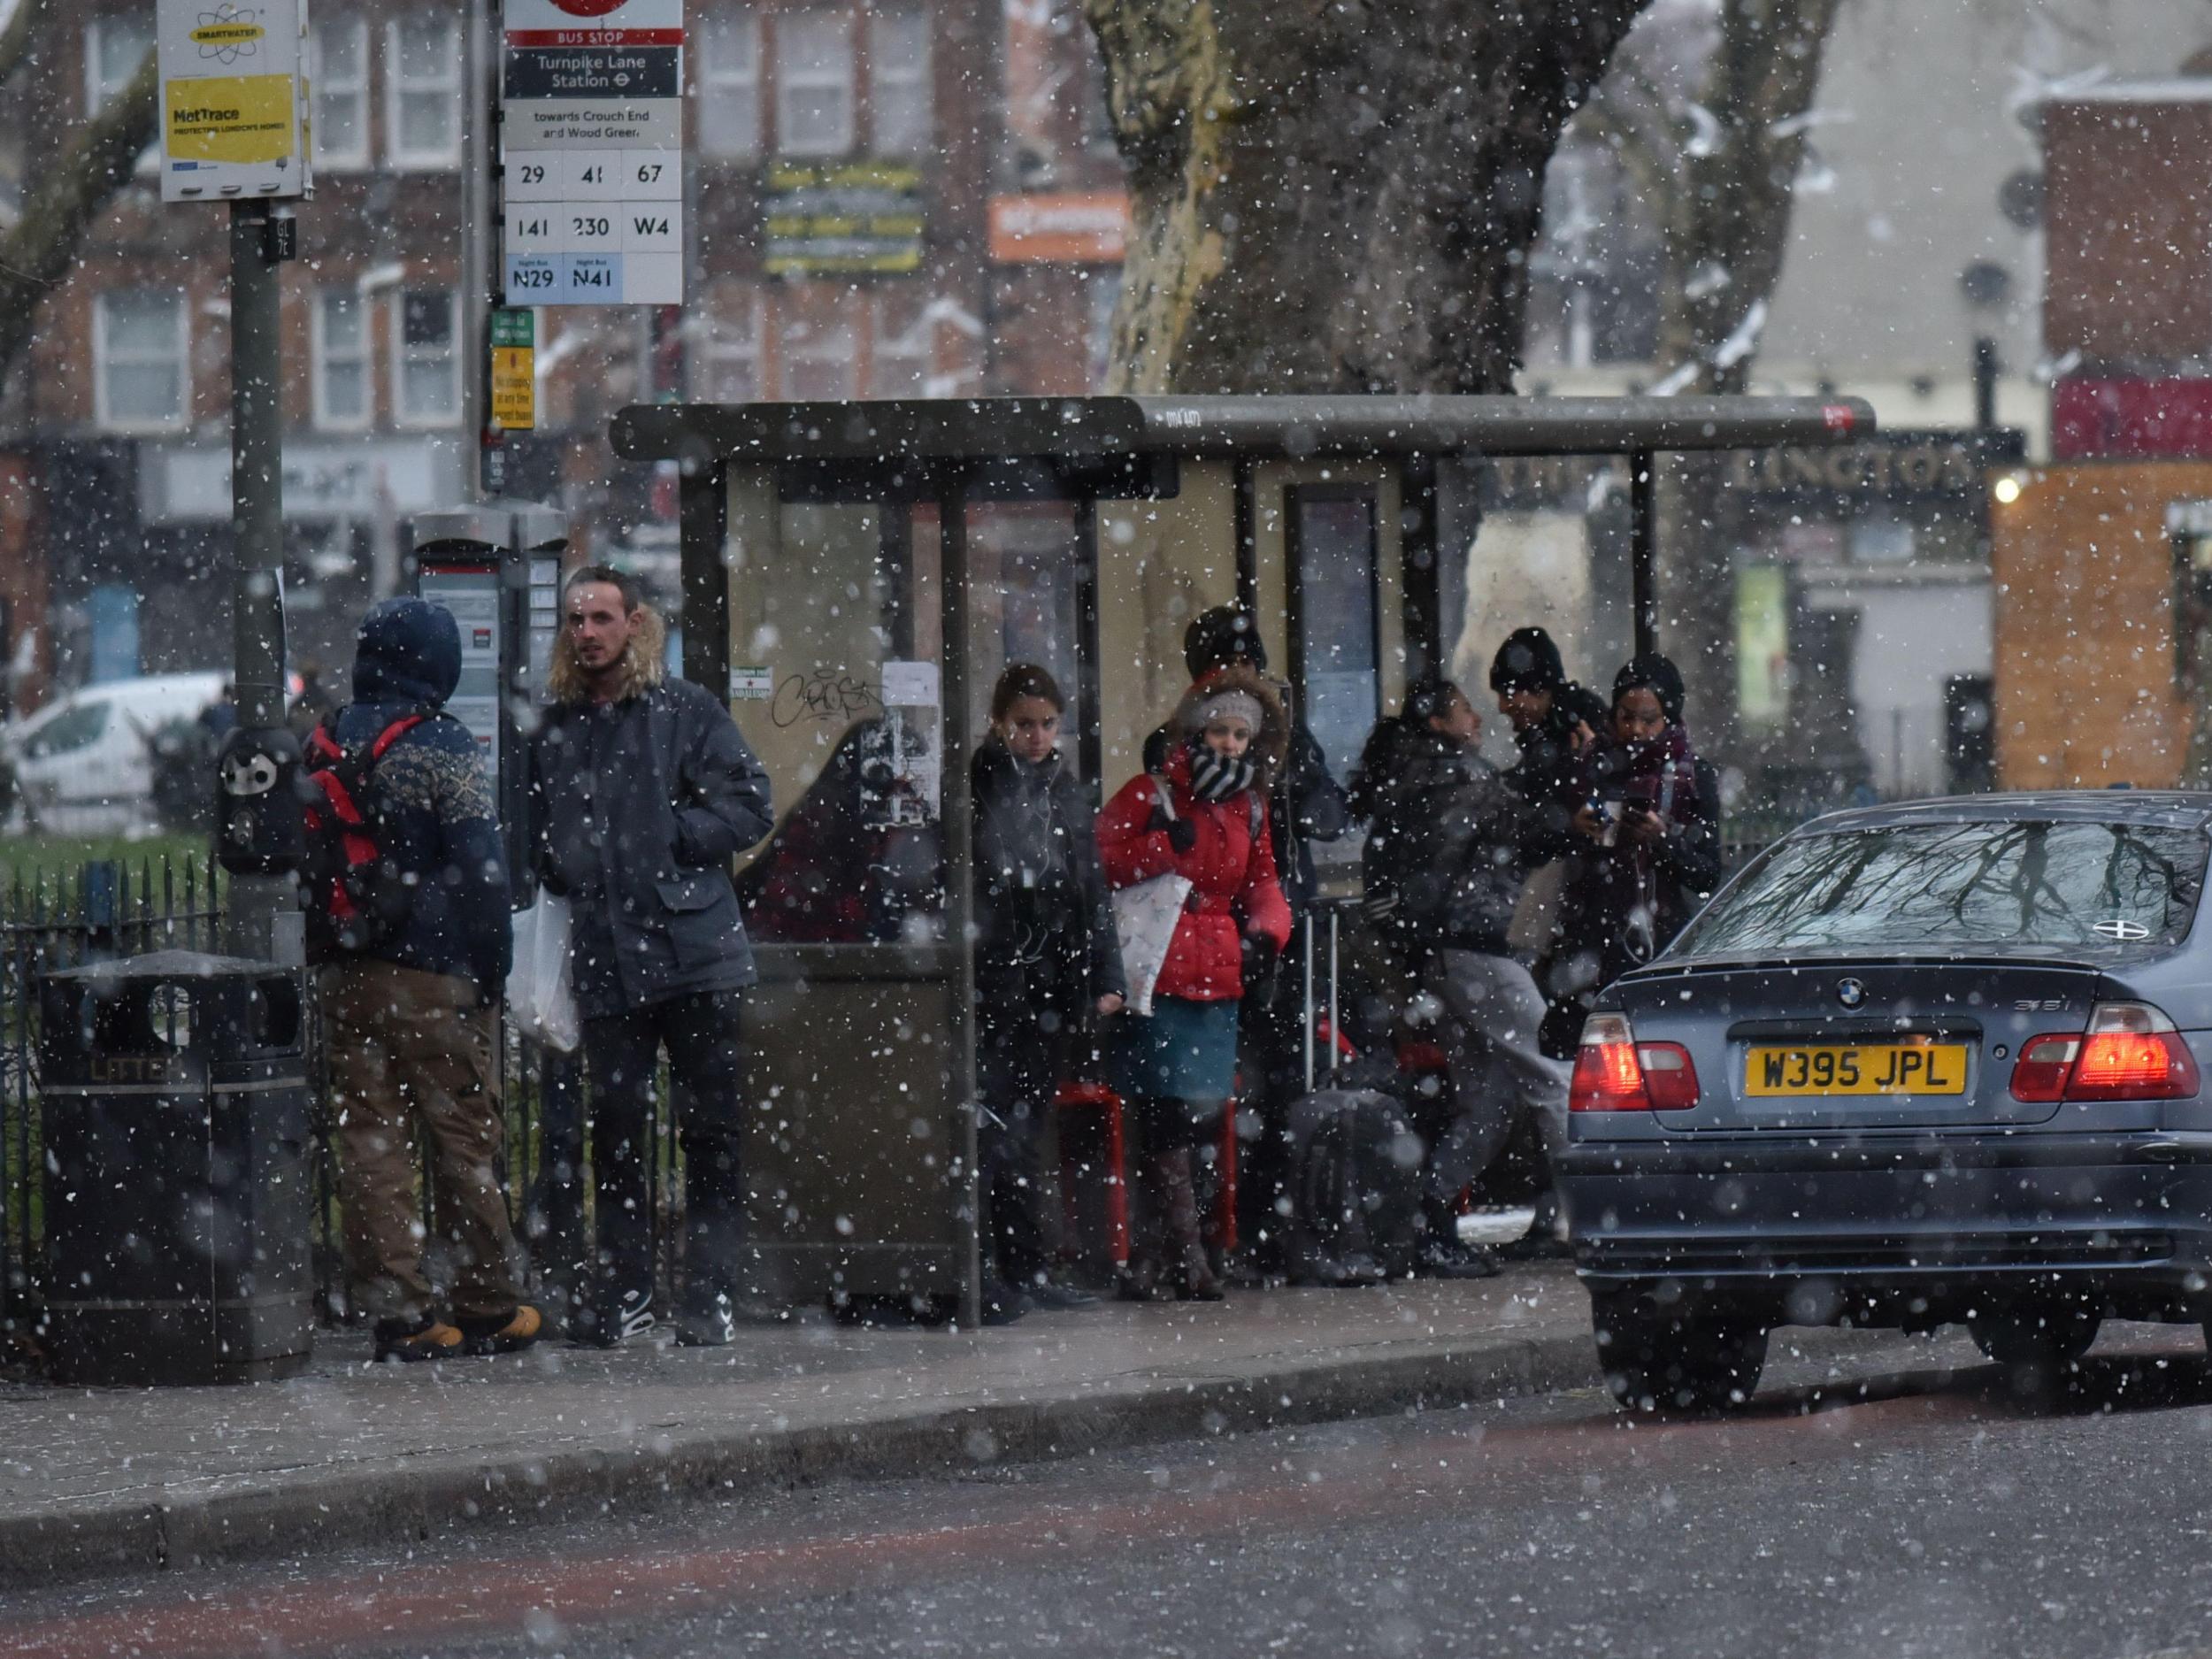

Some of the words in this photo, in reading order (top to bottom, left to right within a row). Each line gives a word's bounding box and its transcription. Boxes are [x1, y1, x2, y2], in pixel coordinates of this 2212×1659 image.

[197, 28, 257, 40] SMARTWATER
[558, 32, 583, 43] BUS
[588, 32, 624, 43] STOP
[538, 55, 603, 72] Turnpike
[608, 55, 646, 68] Lane
[552, 73, 609, 88] Station
[173, 108, 240, 123] MetTrace
[534, 111, 580, 122] towards
[583, 111, 625, 122] Crouch
[628, 111, 649, 121] End
[543, 127, 564, 138] and
[568, 127, 601, 138] Wood
[521, 165, 545, 183] 29
[581, 165, 603, 183] 41
[637, 165, 662, 183] 67
[518, 219, 548, 236] 141
[572, 218, 610, 236] 230
[634, 217, 669, 235] W4
[513, 270, 554, 288] N29
[572, 269, 611, 288] N41
[1764, 1051, 1860, 1087] W395
[1874, 1050, 1947, 1087] JPL
